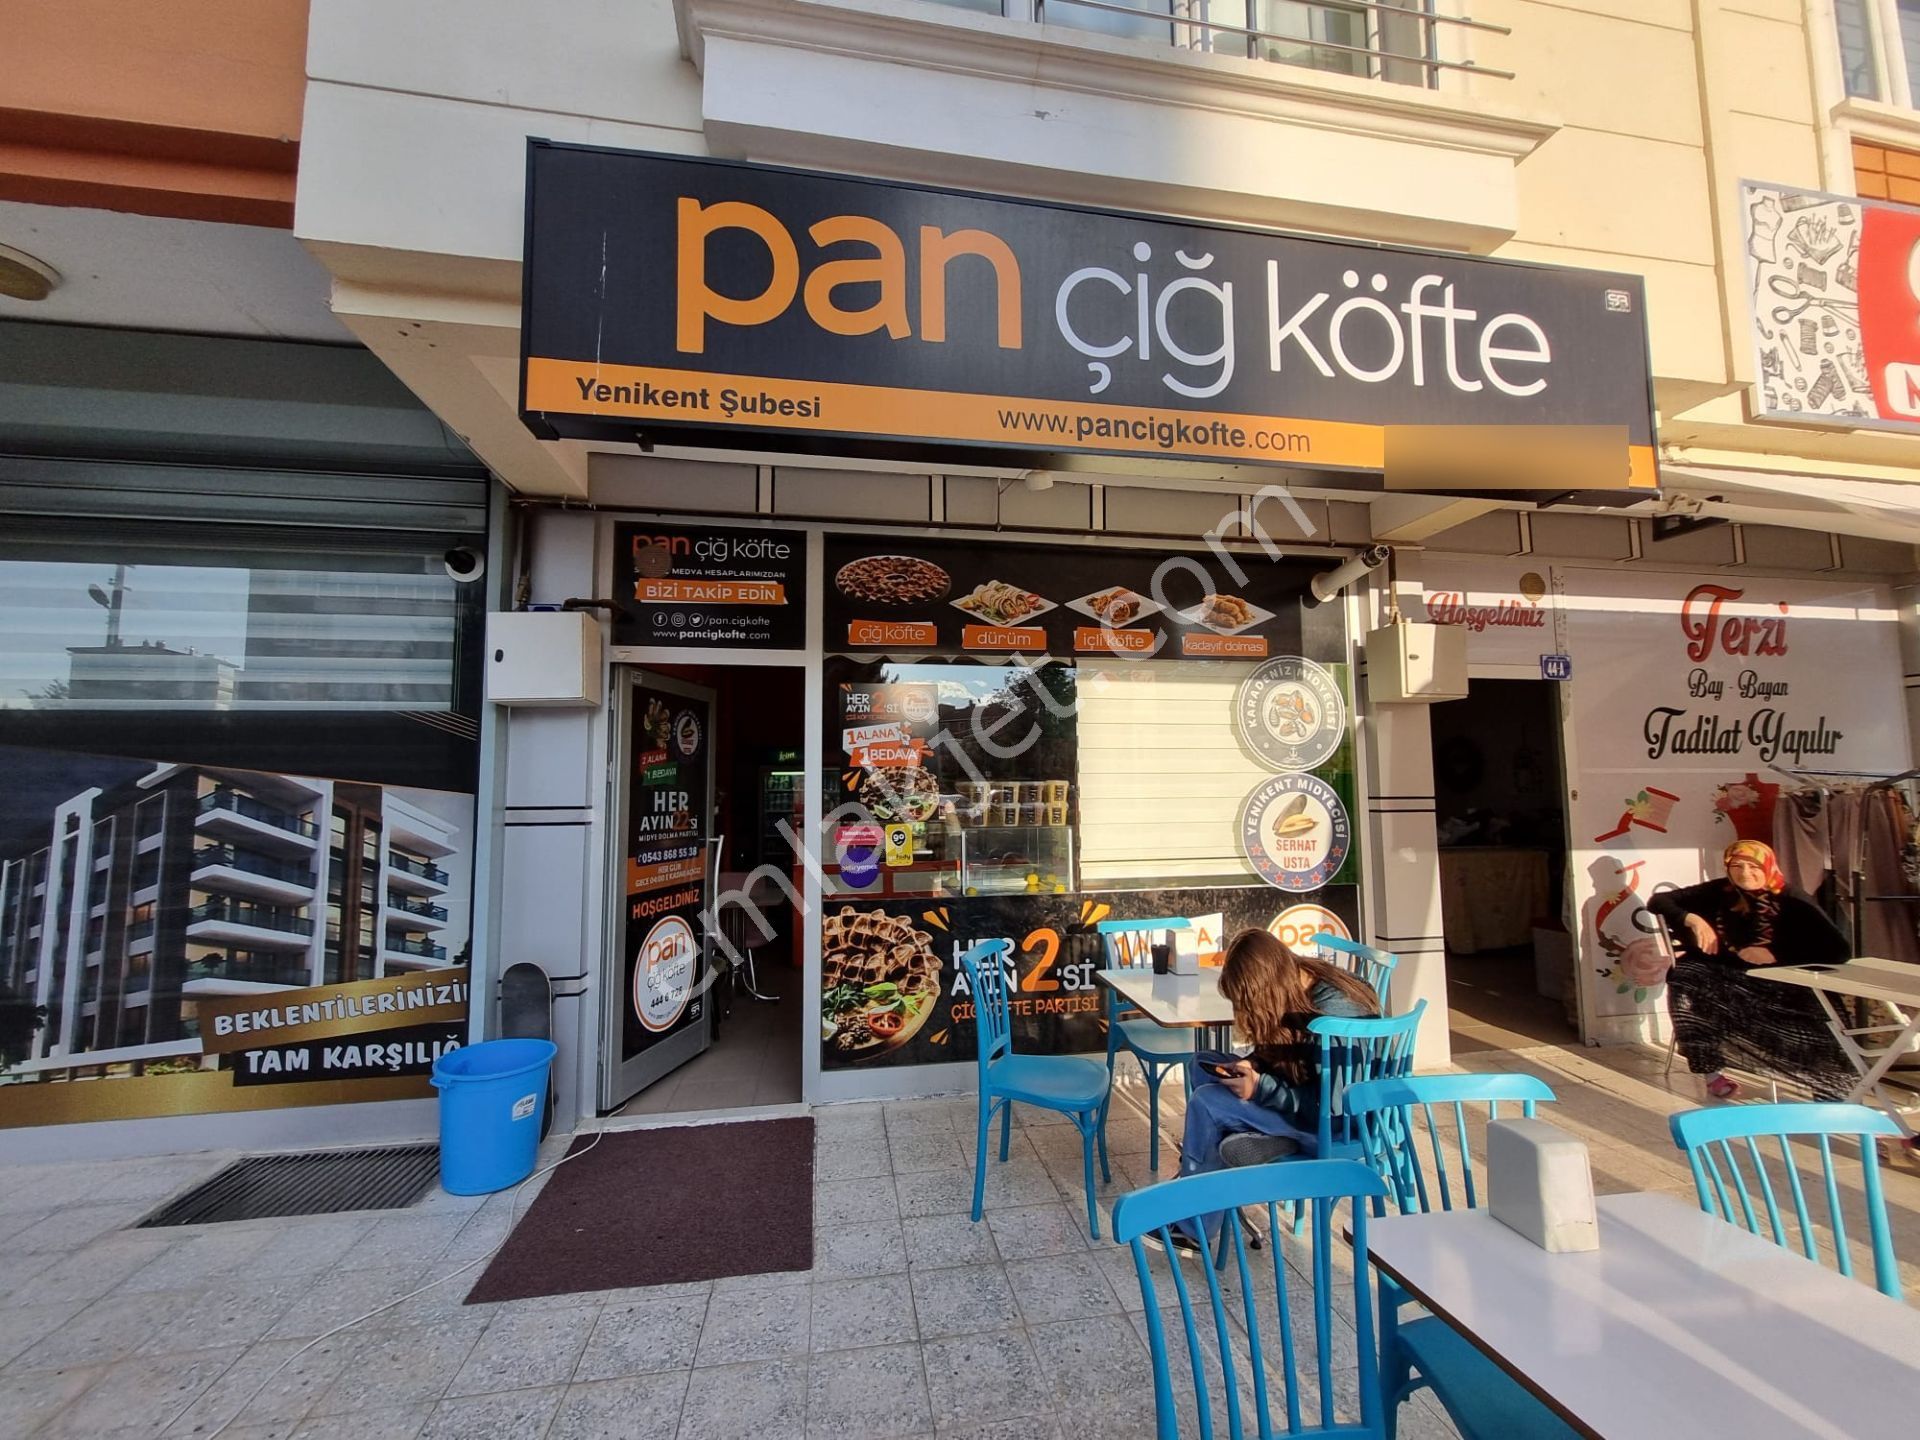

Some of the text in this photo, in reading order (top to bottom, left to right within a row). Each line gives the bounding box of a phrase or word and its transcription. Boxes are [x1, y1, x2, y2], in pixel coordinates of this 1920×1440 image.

[676, 197, 1551, 398] pan çiğ köfte
[576, 377, 820, 417] Yenikent Şubesi
[998, 409, 1311, 452] www.pancigkofte.com
[695, 537, 728, 562] çiğ
[733, 538, 791, 559] köfte
[672, 567, 703, 576] MEDYA
[705, 569, 786, 578] HESAPLARIMIZDAN
[646, 582, 776, 600] BİZİ TAKİP EDİN
[1427, 591, 1545, 632] Hoşgeldiniz
[1681, 584, 1788, 662] Terzi
[859, 624, 926, 643] çiğ köfte
[977, 630, 1031, 646] dürüm
[1083, 632, 1145, 650] içli köfte
[1688, 668, 1723, 701] Bay
[1738, 669, 1789, 701] Bayan
[846, 693, 870, 705] HER
[846, 704, 870, 713] AYIN
[1644, 706, 1844, 765] Tadilat Yapılır
[870, 748, 918, 761] BEDAVA
[654, 791, 689, 812] HER
[640, 815, 673, 831] AYIN
[1276, 838, 1317, 851] SERHAT
[1283, 855, 1310, 869] USTA
[632, 888, 700, 920] HOŞGELDİNİZ
[646, 932, 686, 974] pan
[1035, 995, 1099, 1014] PARTİSİ
[245, 1048, 310, 1075] TAM
